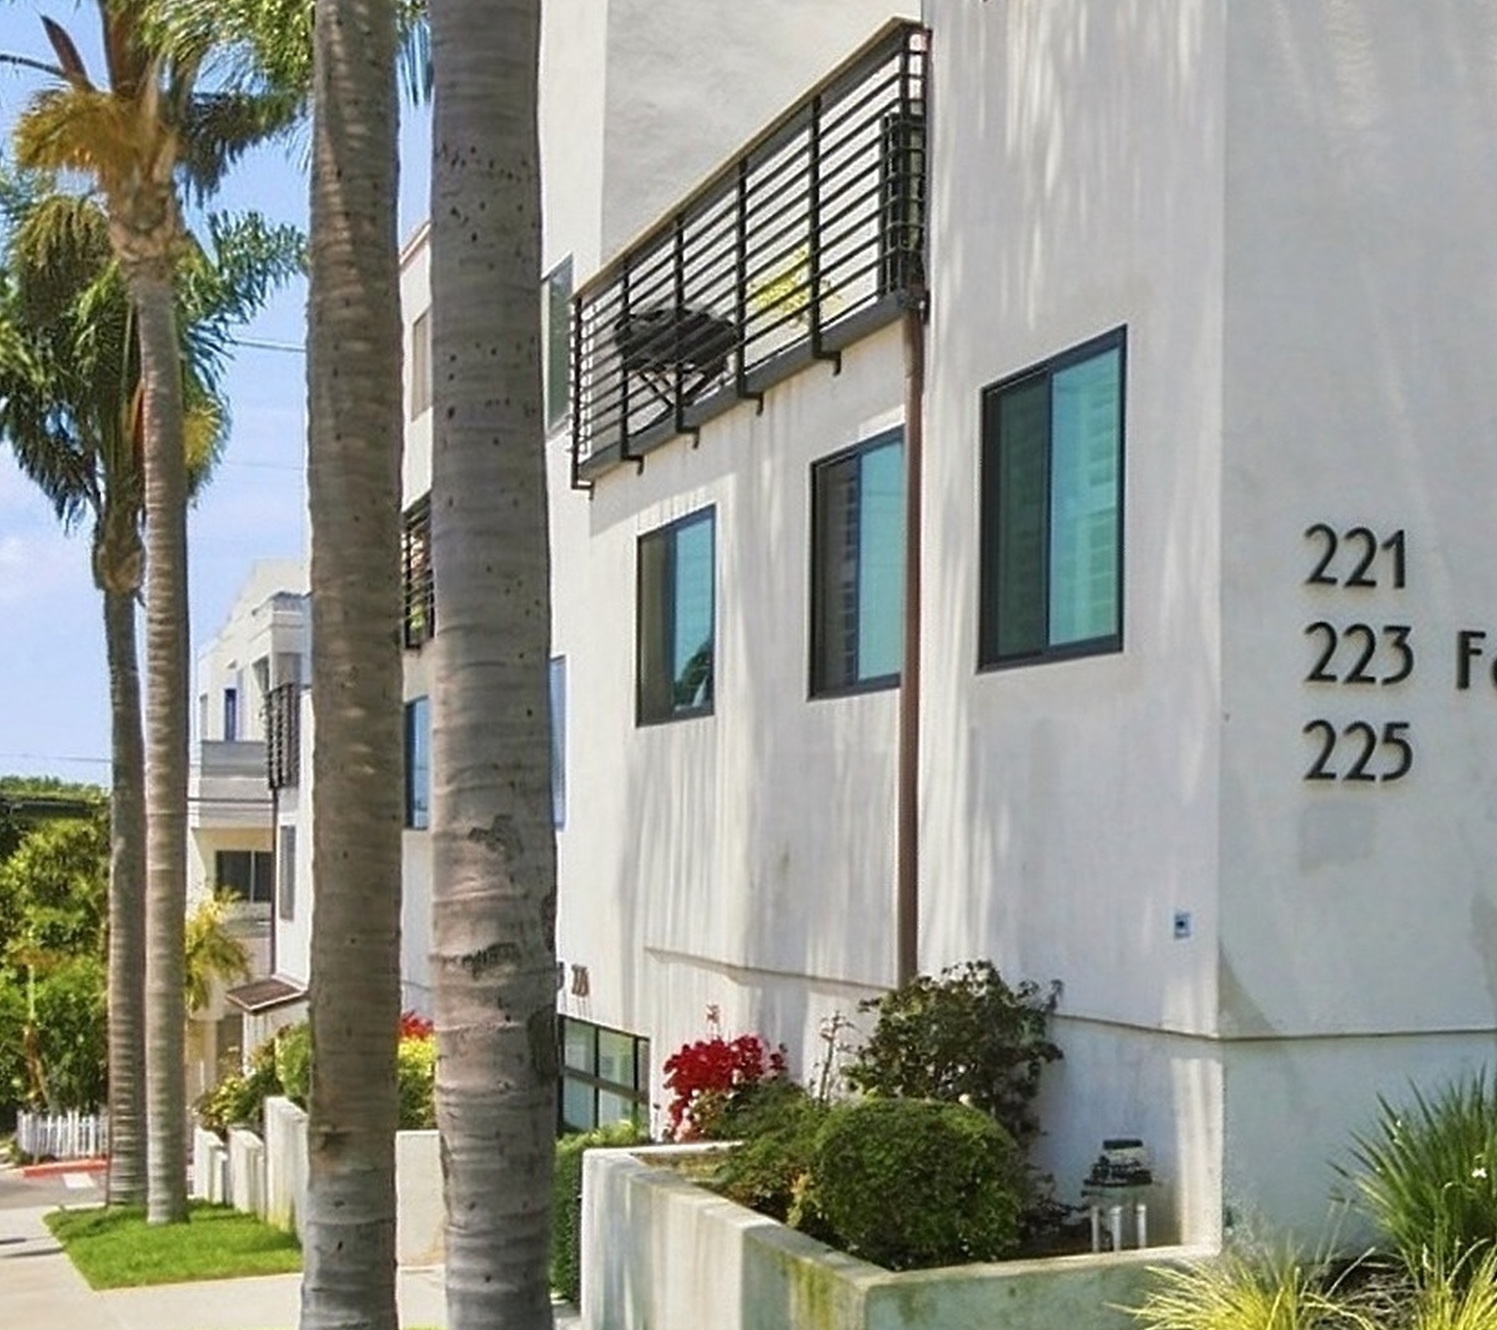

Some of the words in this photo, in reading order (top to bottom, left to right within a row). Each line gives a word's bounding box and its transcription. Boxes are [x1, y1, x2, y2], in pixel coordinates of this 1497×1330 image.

[1303, 523, 1407, 590] 221
[1303, 621, 1416, 686] 223
[1303, 719, 1416, 782] 225
